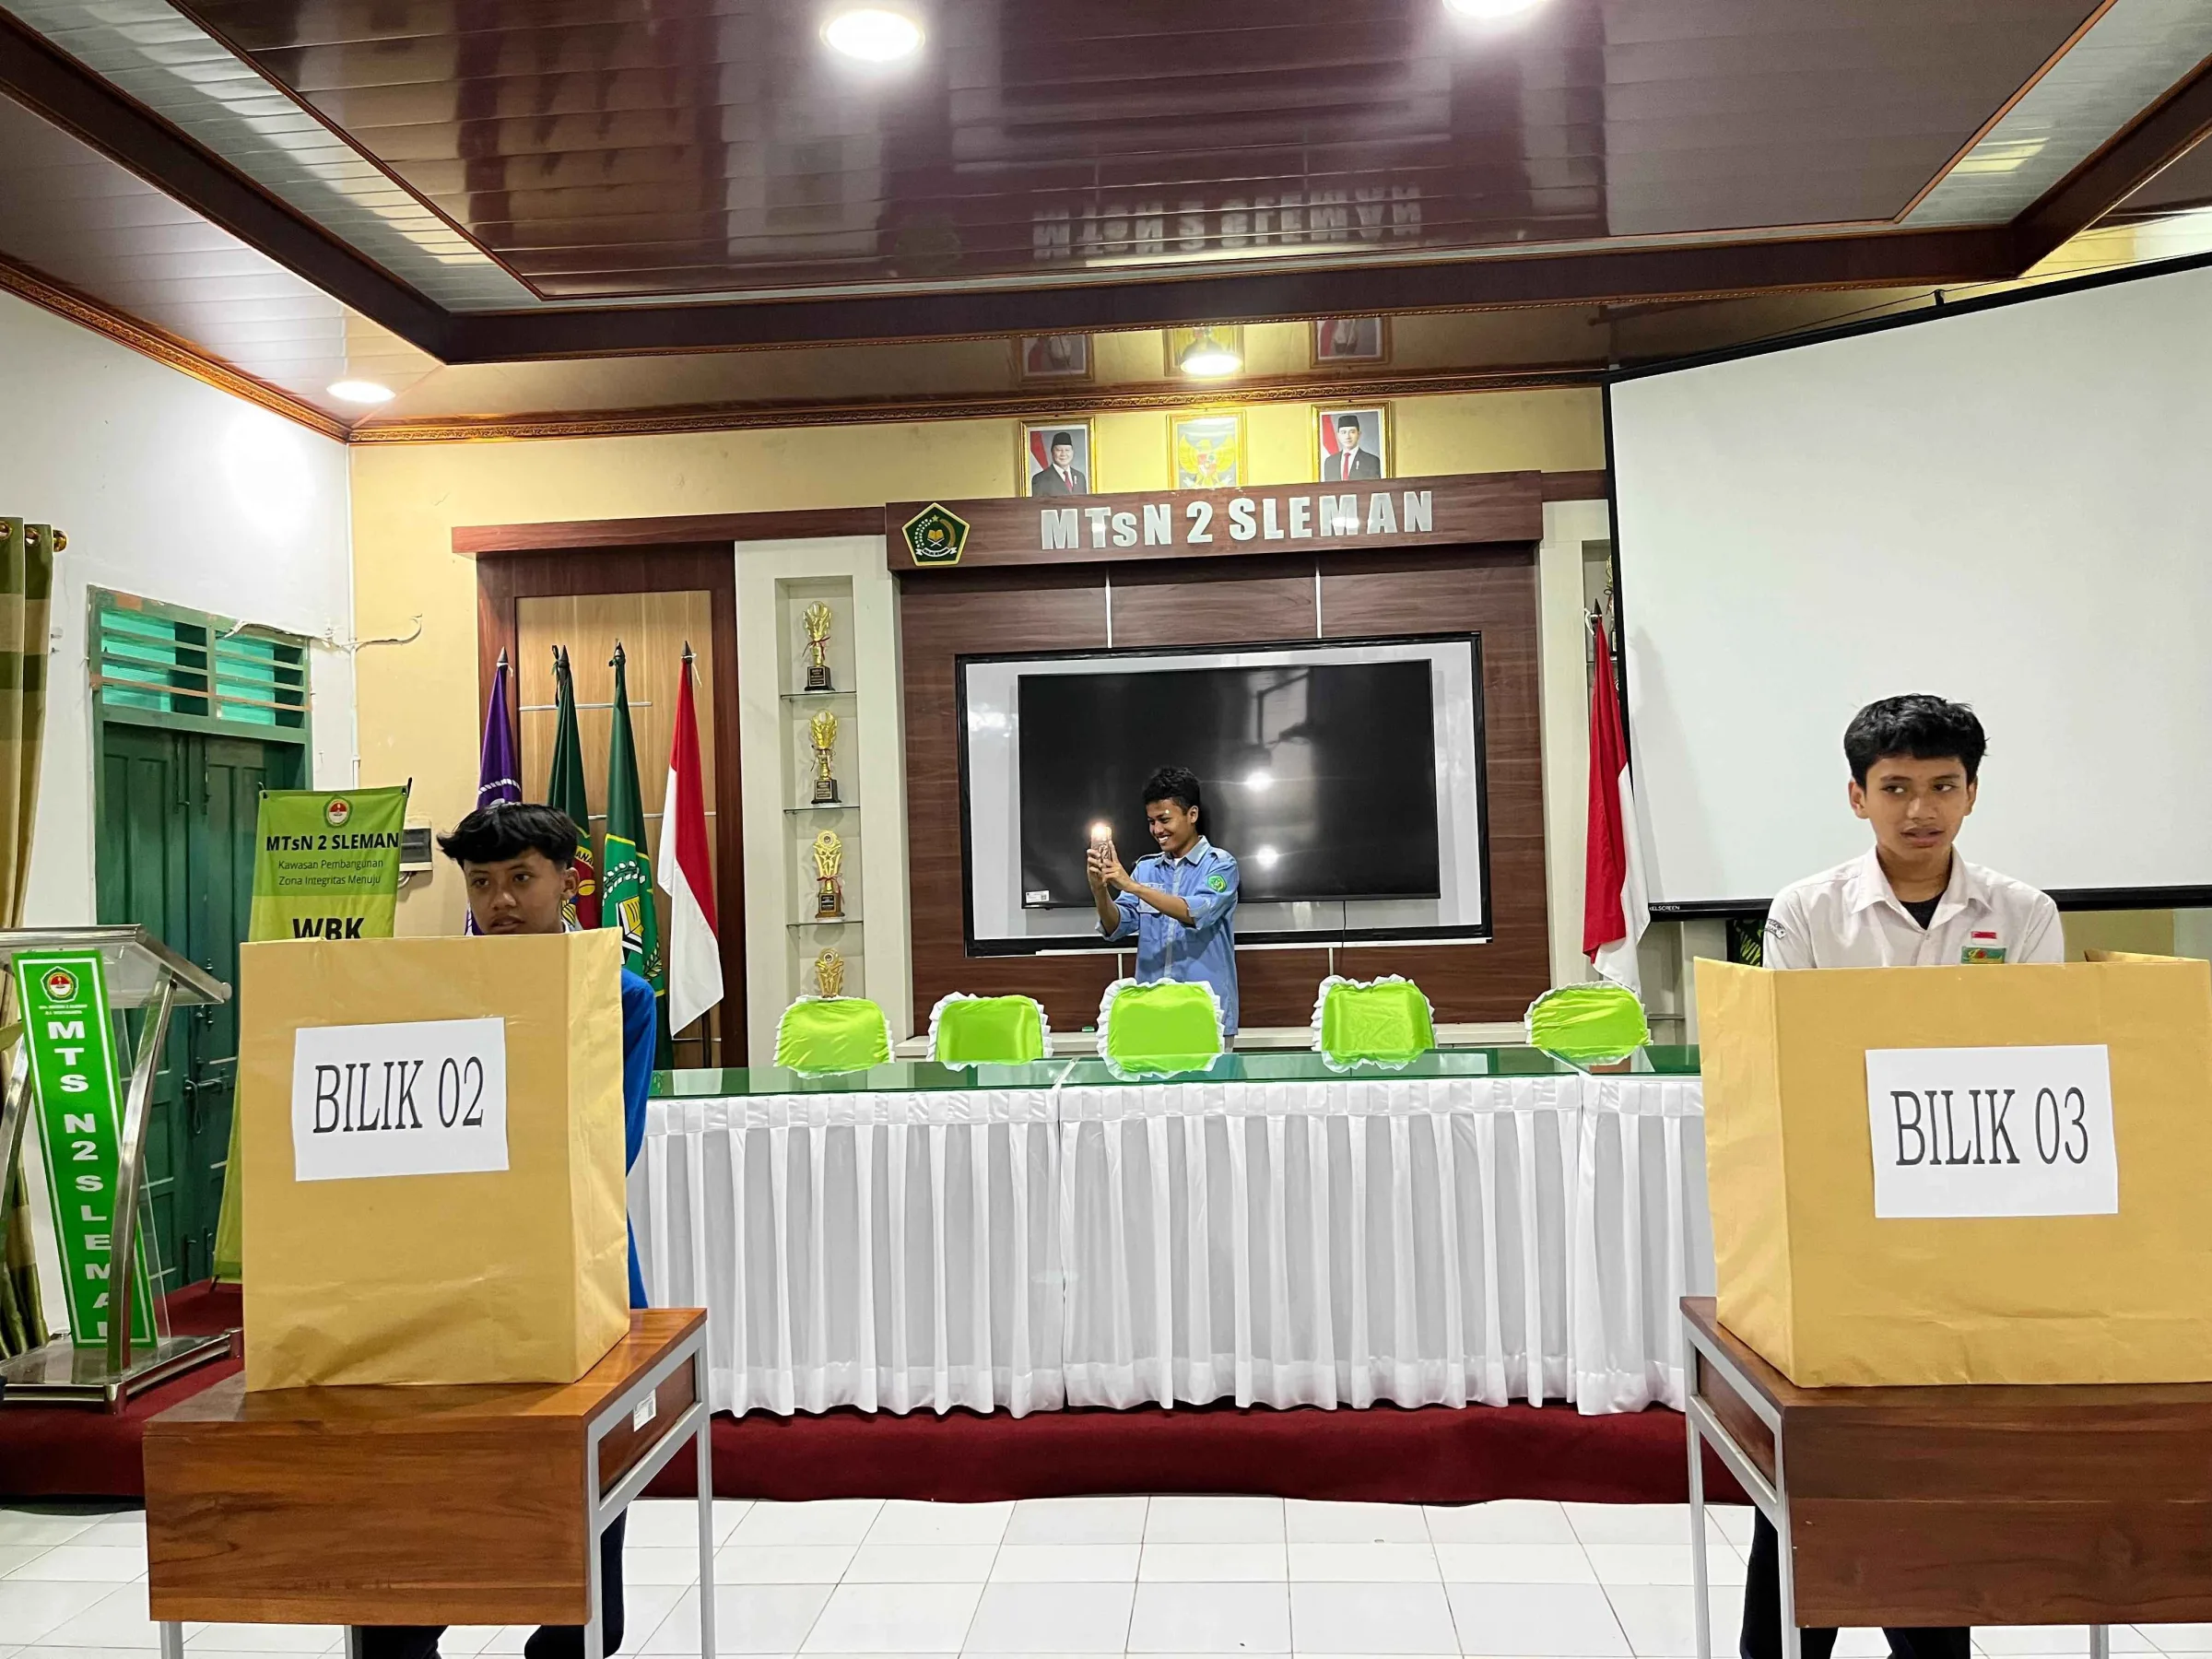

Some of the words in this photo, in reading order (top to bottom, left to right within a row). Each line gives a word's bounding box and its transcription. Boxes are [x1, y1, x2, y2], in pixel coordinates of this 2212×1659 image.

[1041, 503, 1172, 550] MTsN
[1186, 500, 1213, 544] 2
[1228, 490, 1432, 542] SLEMAN
[266, 835, 313, 852] MTsN
[317, 834, 327, 851] 2
[331, 832, 399, 850] SLEMAN
[278, 860, 318, 870] Kawasan
[321, 859, 383, 871] Pembangunan
[278, 876, 302, 886] Zona
[305, 876, 346, 888] Integritas
[347, 875, 381, 887] Menuju
[292, 917, 365, 940] WBK
[312, 1060, 424, 1134] BILIK
[438, 1056, 485, 1129] 02
[1890, 1088, 2020, 1166] BILIK
[2035, 1087, 2088, 1165] 03
